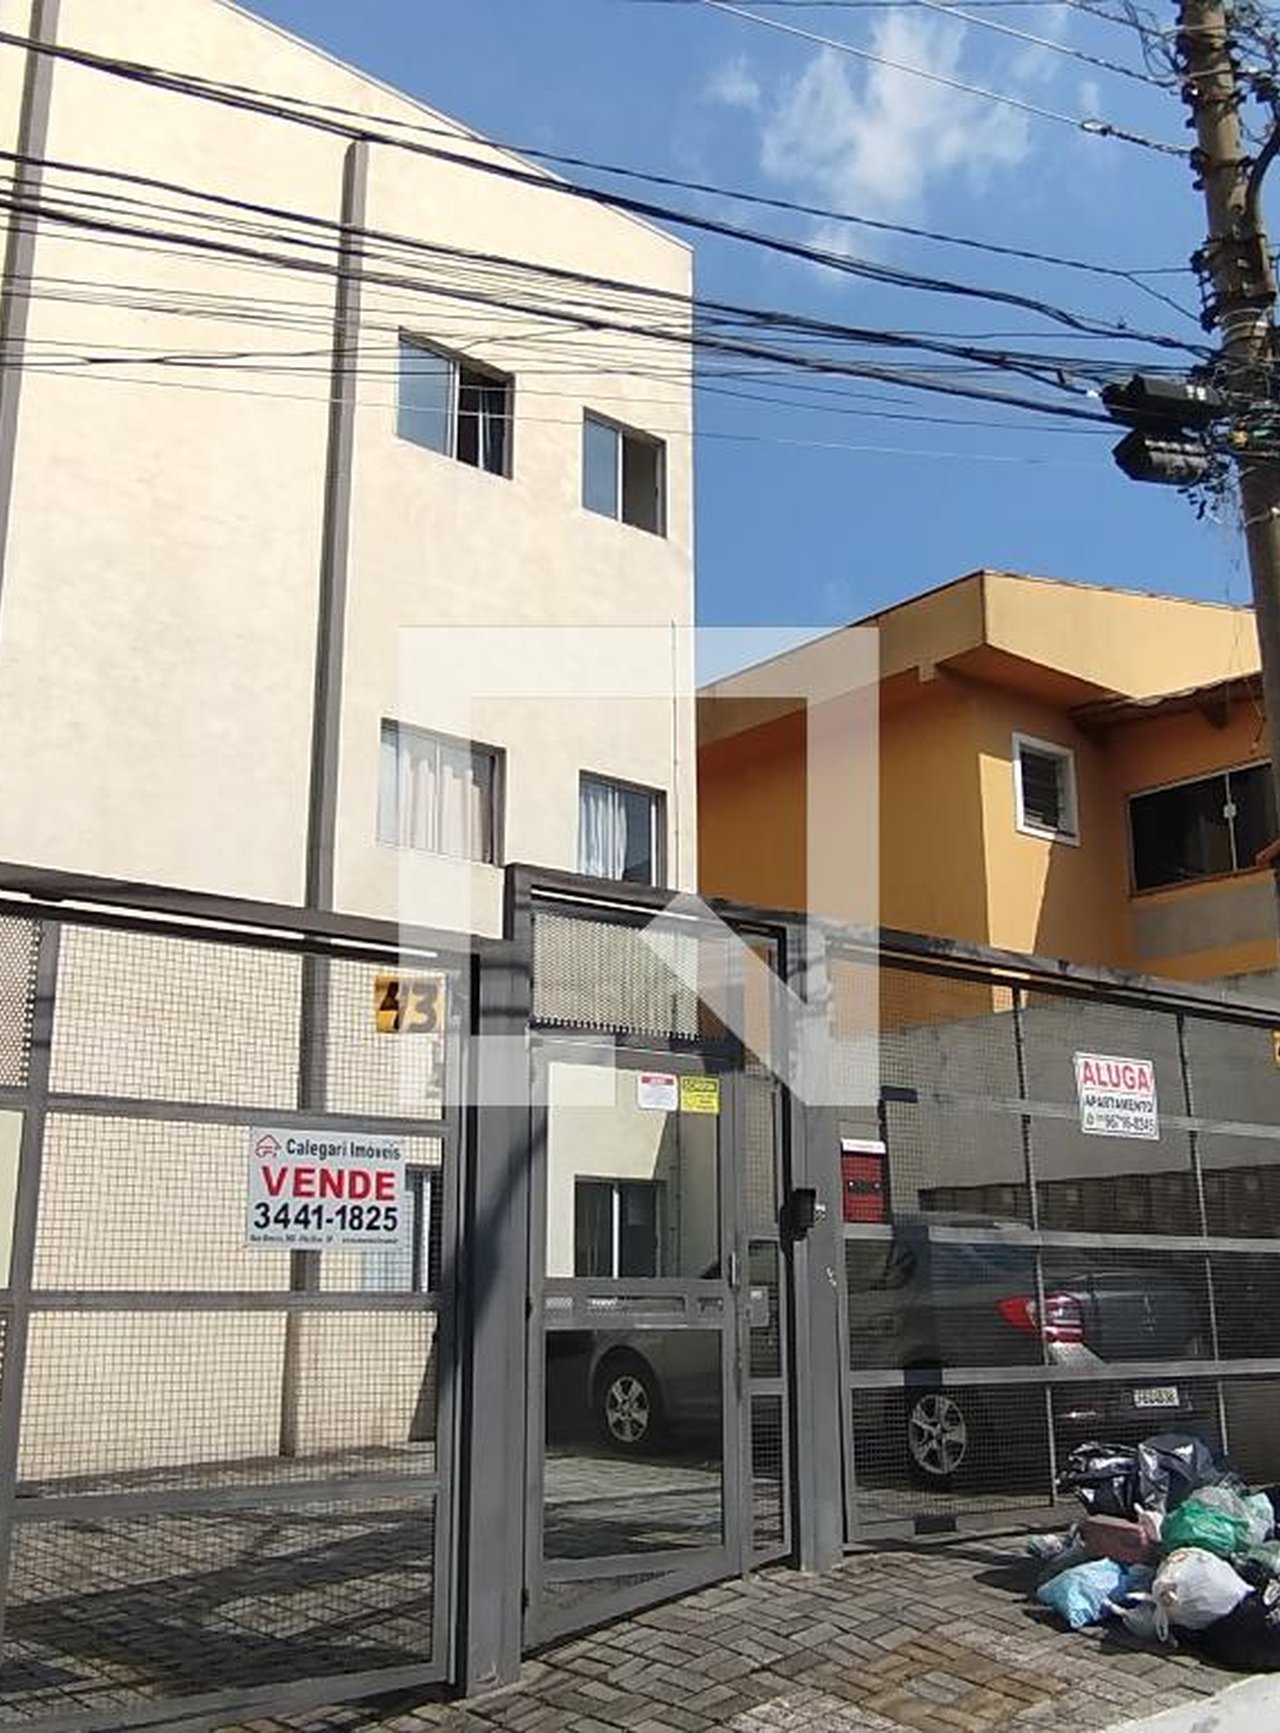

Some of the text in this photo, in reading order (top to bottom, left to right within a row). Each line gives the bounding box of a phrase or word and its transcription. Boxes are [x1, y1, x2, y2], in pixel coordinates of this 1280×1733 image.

[1083, 1060, 1151, 1091] ALUGA
[1085, 1094, 1153, 1113] APARTAMENTO
[286, 1138, 347, 1161] Calegari
[262, 1166, 395, 1201] VENDE
[254, 1202, 398, 1231] 3441-1825
